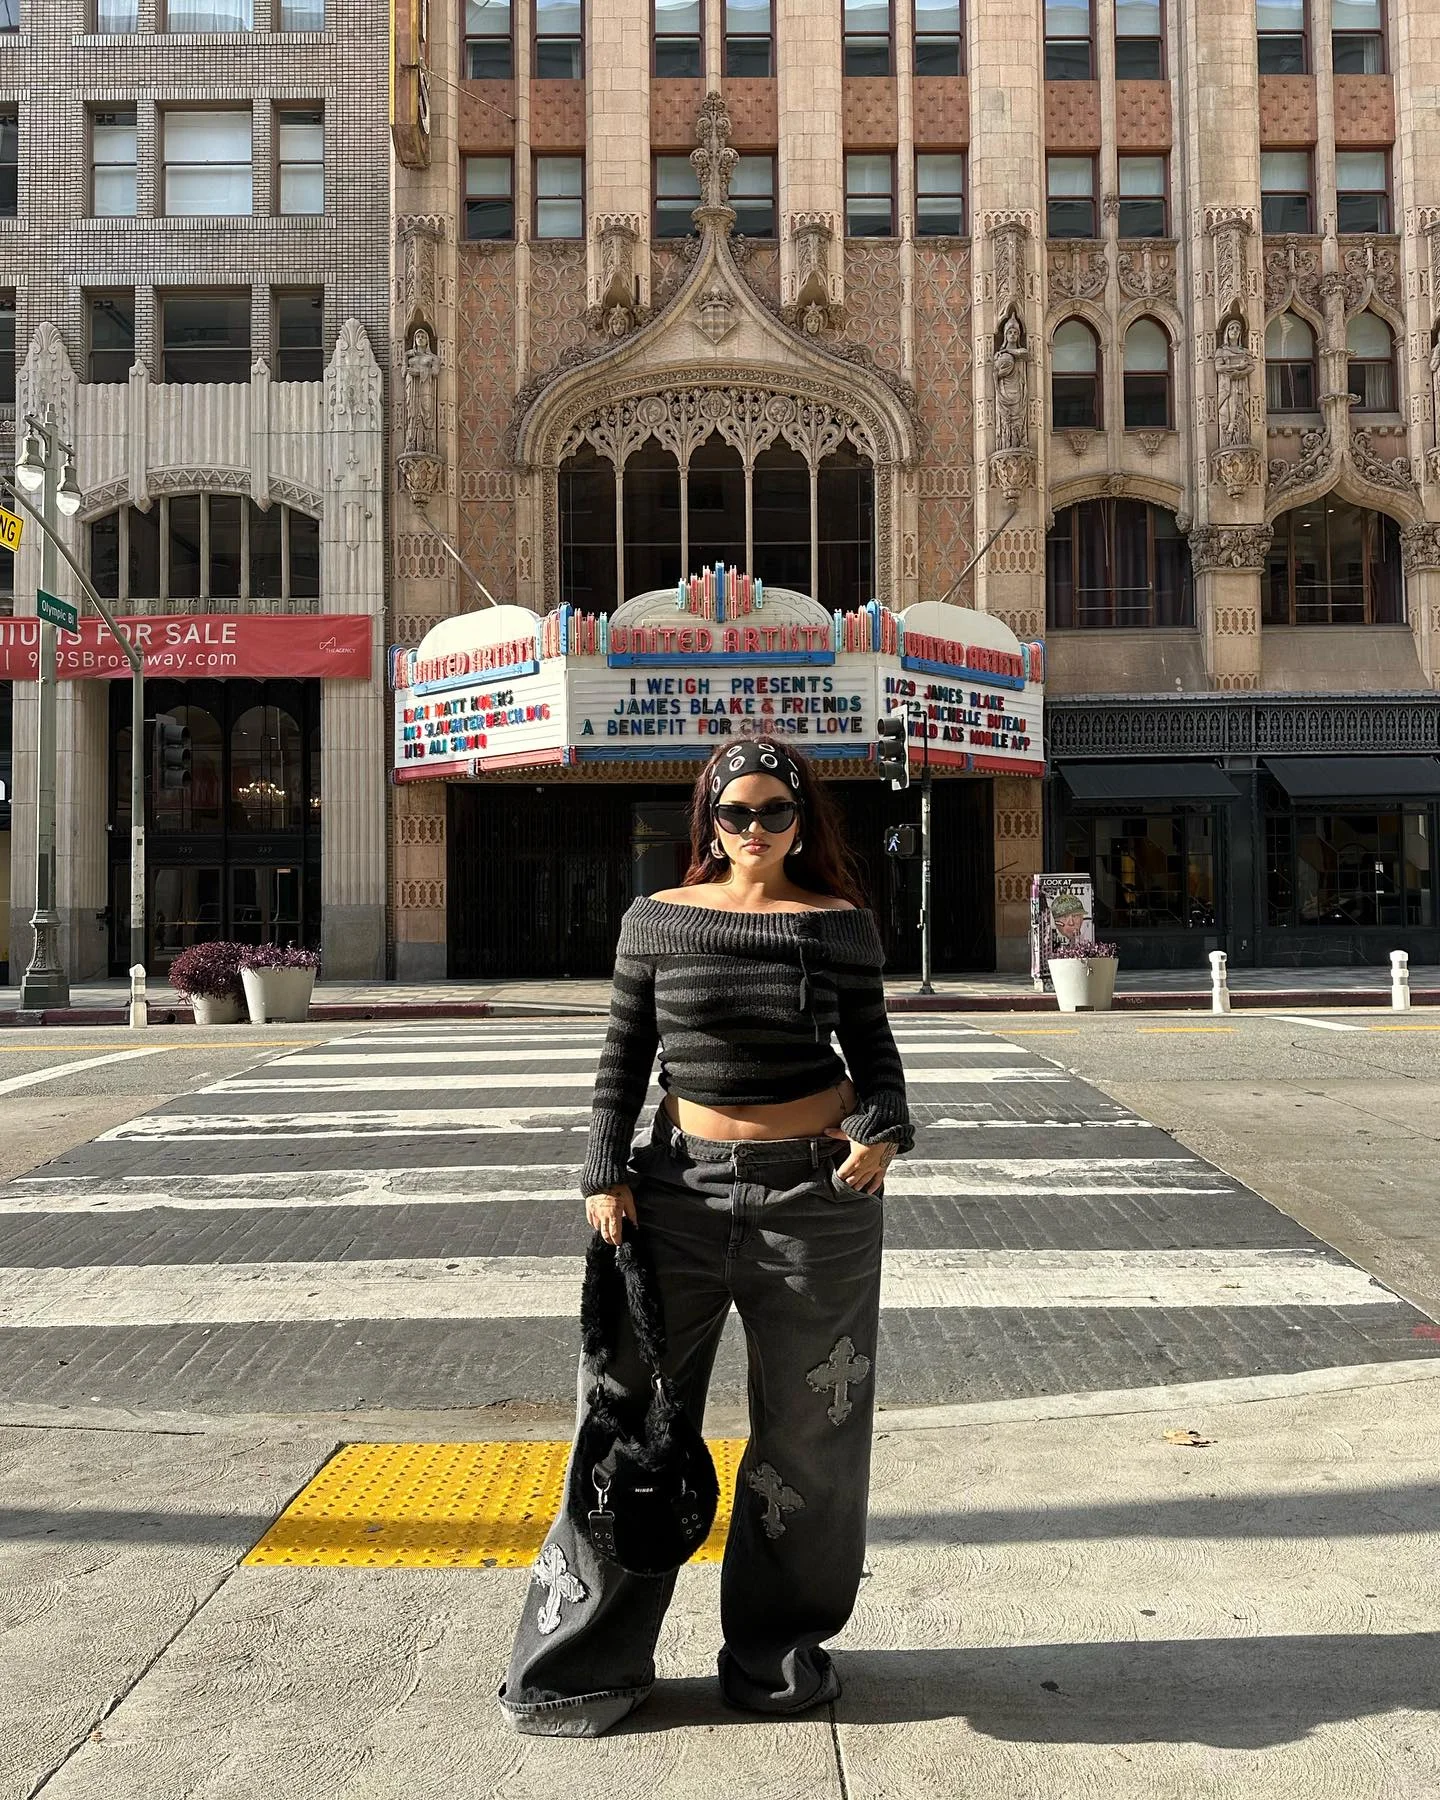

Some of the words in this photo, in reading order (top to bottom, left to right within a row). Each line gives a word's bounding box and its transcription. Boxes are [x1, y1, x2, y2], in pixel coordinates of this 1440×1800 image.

[41, 600, 66, 621] Olympic
[97, 623, 152, 645] FOR
[165, 623, 237, 645] SALE
[610, 627, 714, 654] UNITED
[723, 624, 830, 652] ARTISTS
[904, 631, 965, 666] UNITED
[28, 651, 237, 669] 99SBroaway.com
[630, 678, 636, 695] I
[647, 678, 710, 695] WEIGH
[731, 676, 833, 694] PRESENTS
[886, 677, 916, 697] 11/29
[924, 684, 963, 704] JAMES
[970, 691, 1005, 712] BLAKE
[434, 697, 467, 719] MATT
[614, 698, 681, 715] JAMES
[690, 697, 755, 715] BLAKE
[761, 698, 775, 715] &
[782, 695, 862, 714] FRIENDS
[581, 718, 594, 736] A
[607, 718, 686, 736] BENEFIT
[698, 718, 732, 735] FOR
[816, 716, 863, 734] LOVE
[928, 703, 982, 727] MICHELLE
[987, 713, 1027, 733] BUTEAU
[970, 729, 1009, 749] MOBILE
[1011, 735, 1031, 751] APP
